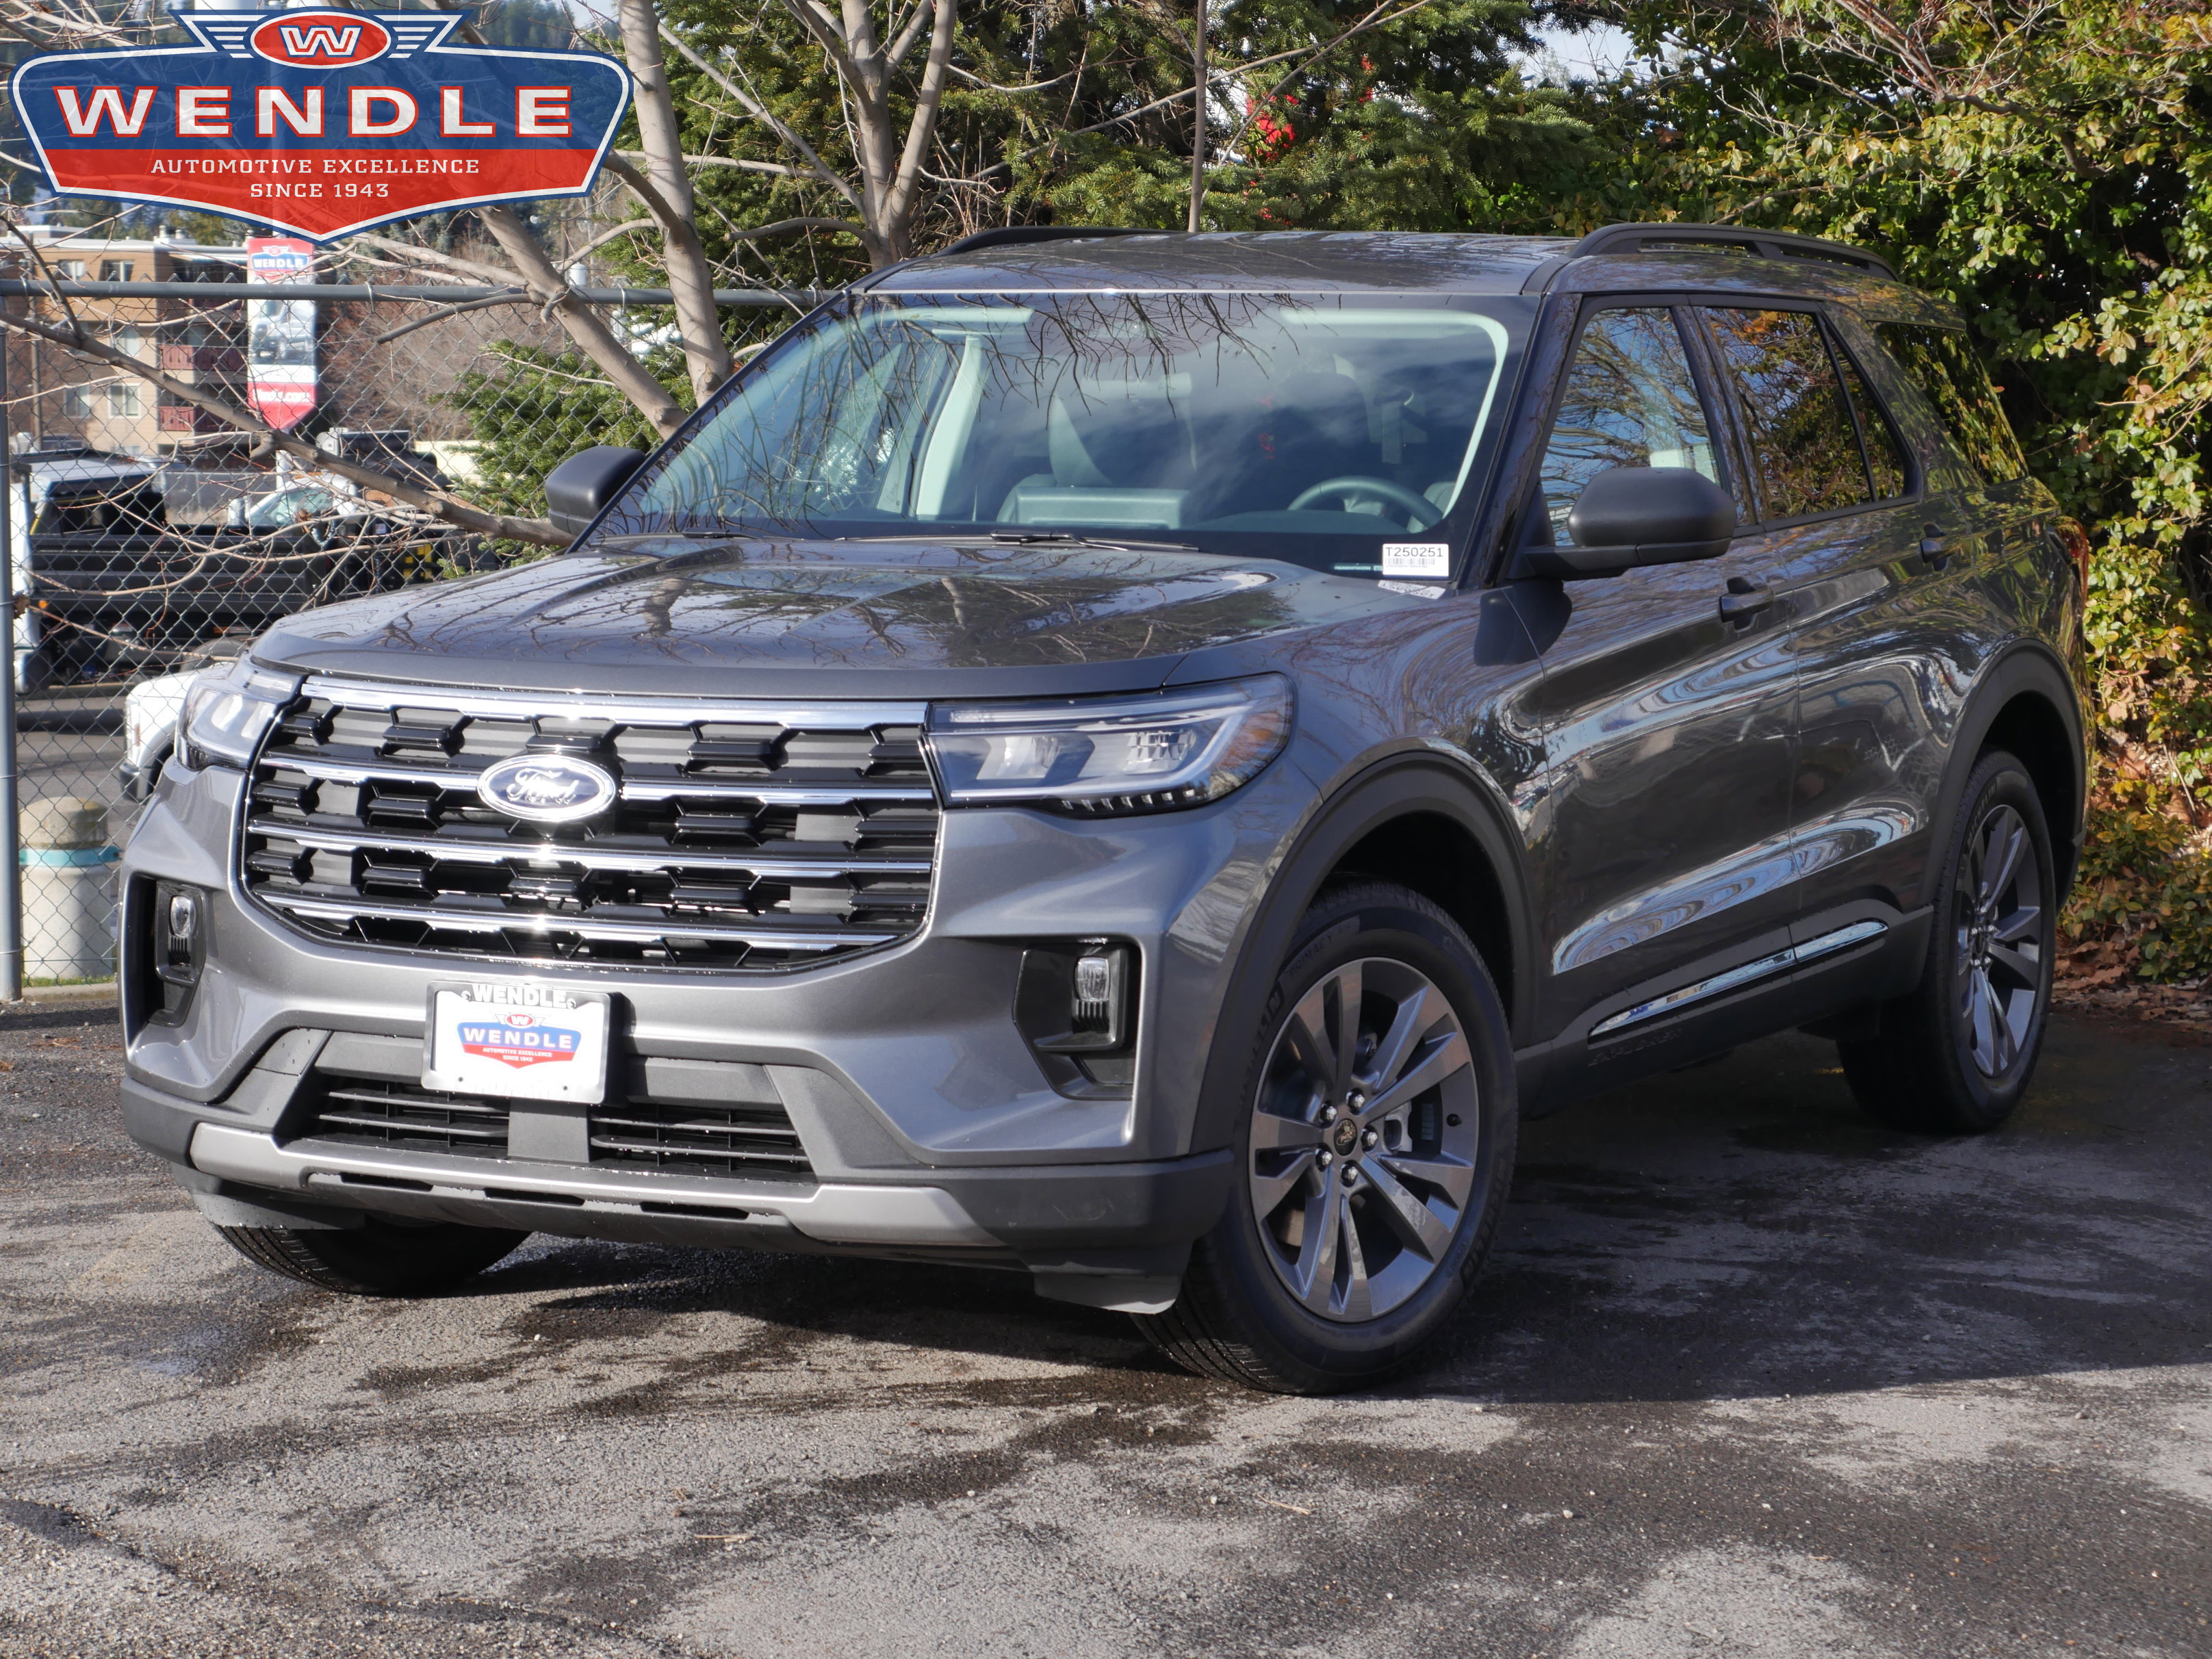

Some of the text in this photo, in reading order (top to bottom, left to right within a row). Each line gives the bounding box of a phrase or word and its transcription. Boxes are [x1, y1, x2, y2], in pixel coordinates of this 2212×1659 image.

[253, 258, 304, 268] WENDLE
[1385, 547, 1443, 557] T250251
[506, 767, 580, 805] Ford
[472, 983, 567, 1007] WENDLE
[463, 1028, 572, 1049] WENDLE
[518, 1049, 552, 1057] EXCELLENCE
